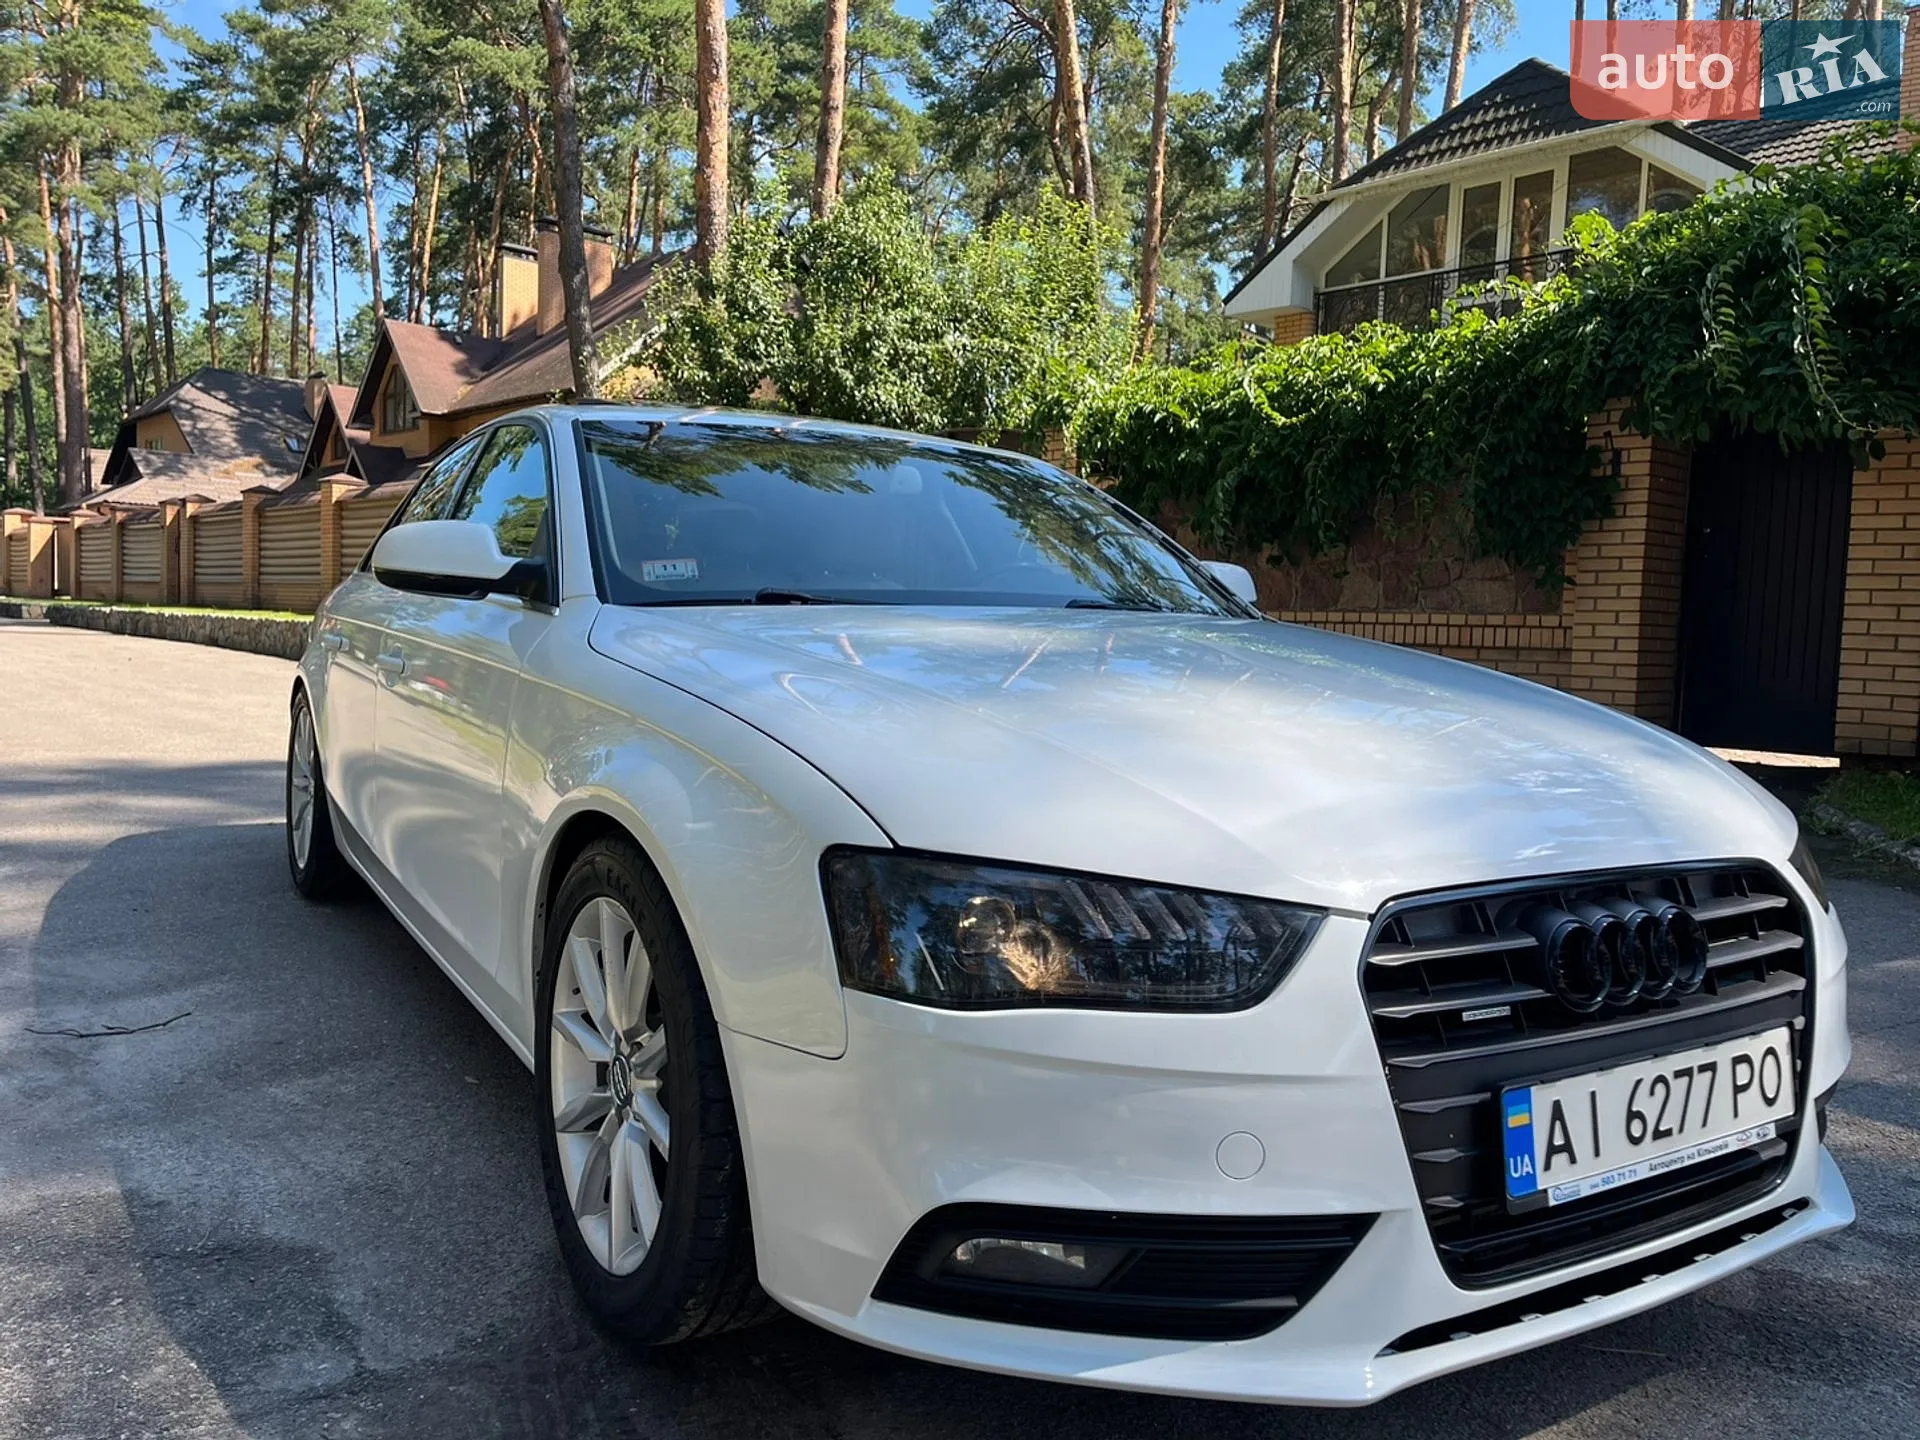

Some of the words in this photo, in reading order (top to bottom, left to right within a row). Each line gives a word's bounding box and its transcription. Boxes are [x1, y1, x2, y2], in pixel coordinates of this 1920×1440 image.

[1543, 1090, 1601, 1172] AI
[1625, 1060, 1718, 1146] 6277
[1731, 1045, 1782, 1119] PO
[1509, 1154, 1534, 1178] UA
